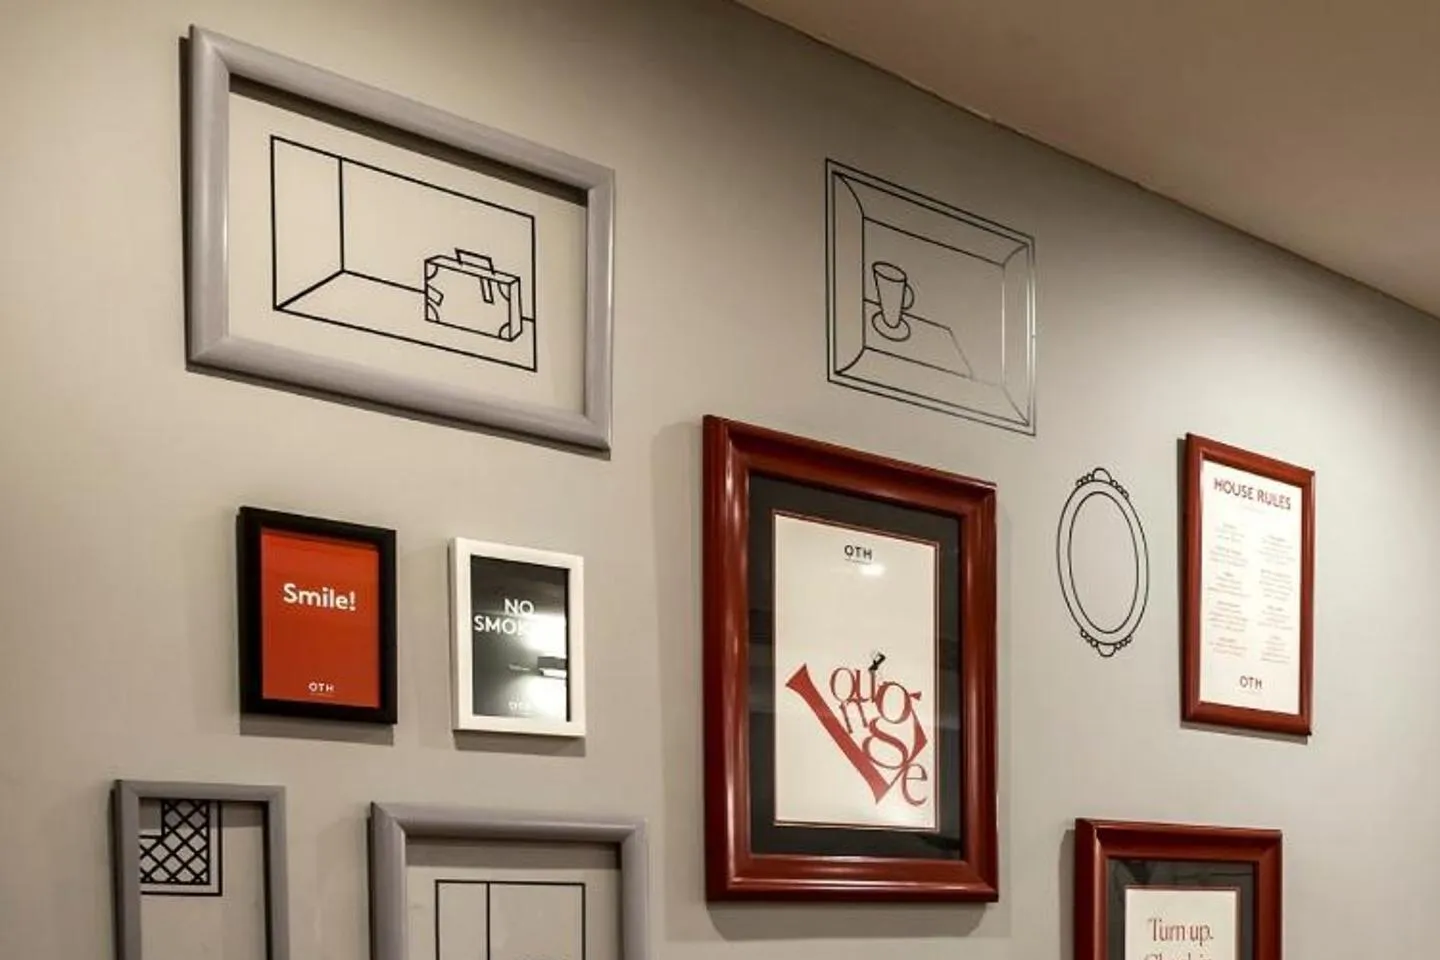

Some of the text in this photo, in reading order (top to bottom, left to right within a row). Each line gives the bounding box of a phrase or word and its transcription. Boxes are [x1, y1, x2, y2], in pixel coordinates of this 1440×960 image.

[1213, 477, 1254, 501] HOUSE
[1257, 489, 1292, 510] RULES
[843, 544, 873, 561] OTH
[282, 582, 357, 612] Smile!
[504, 598, 536, 615] NO
[308, 681, 335, 693] OTH
[1239, 675, 1264, 690] OTH
[1147, 918, 1214, 947] Turn up.
